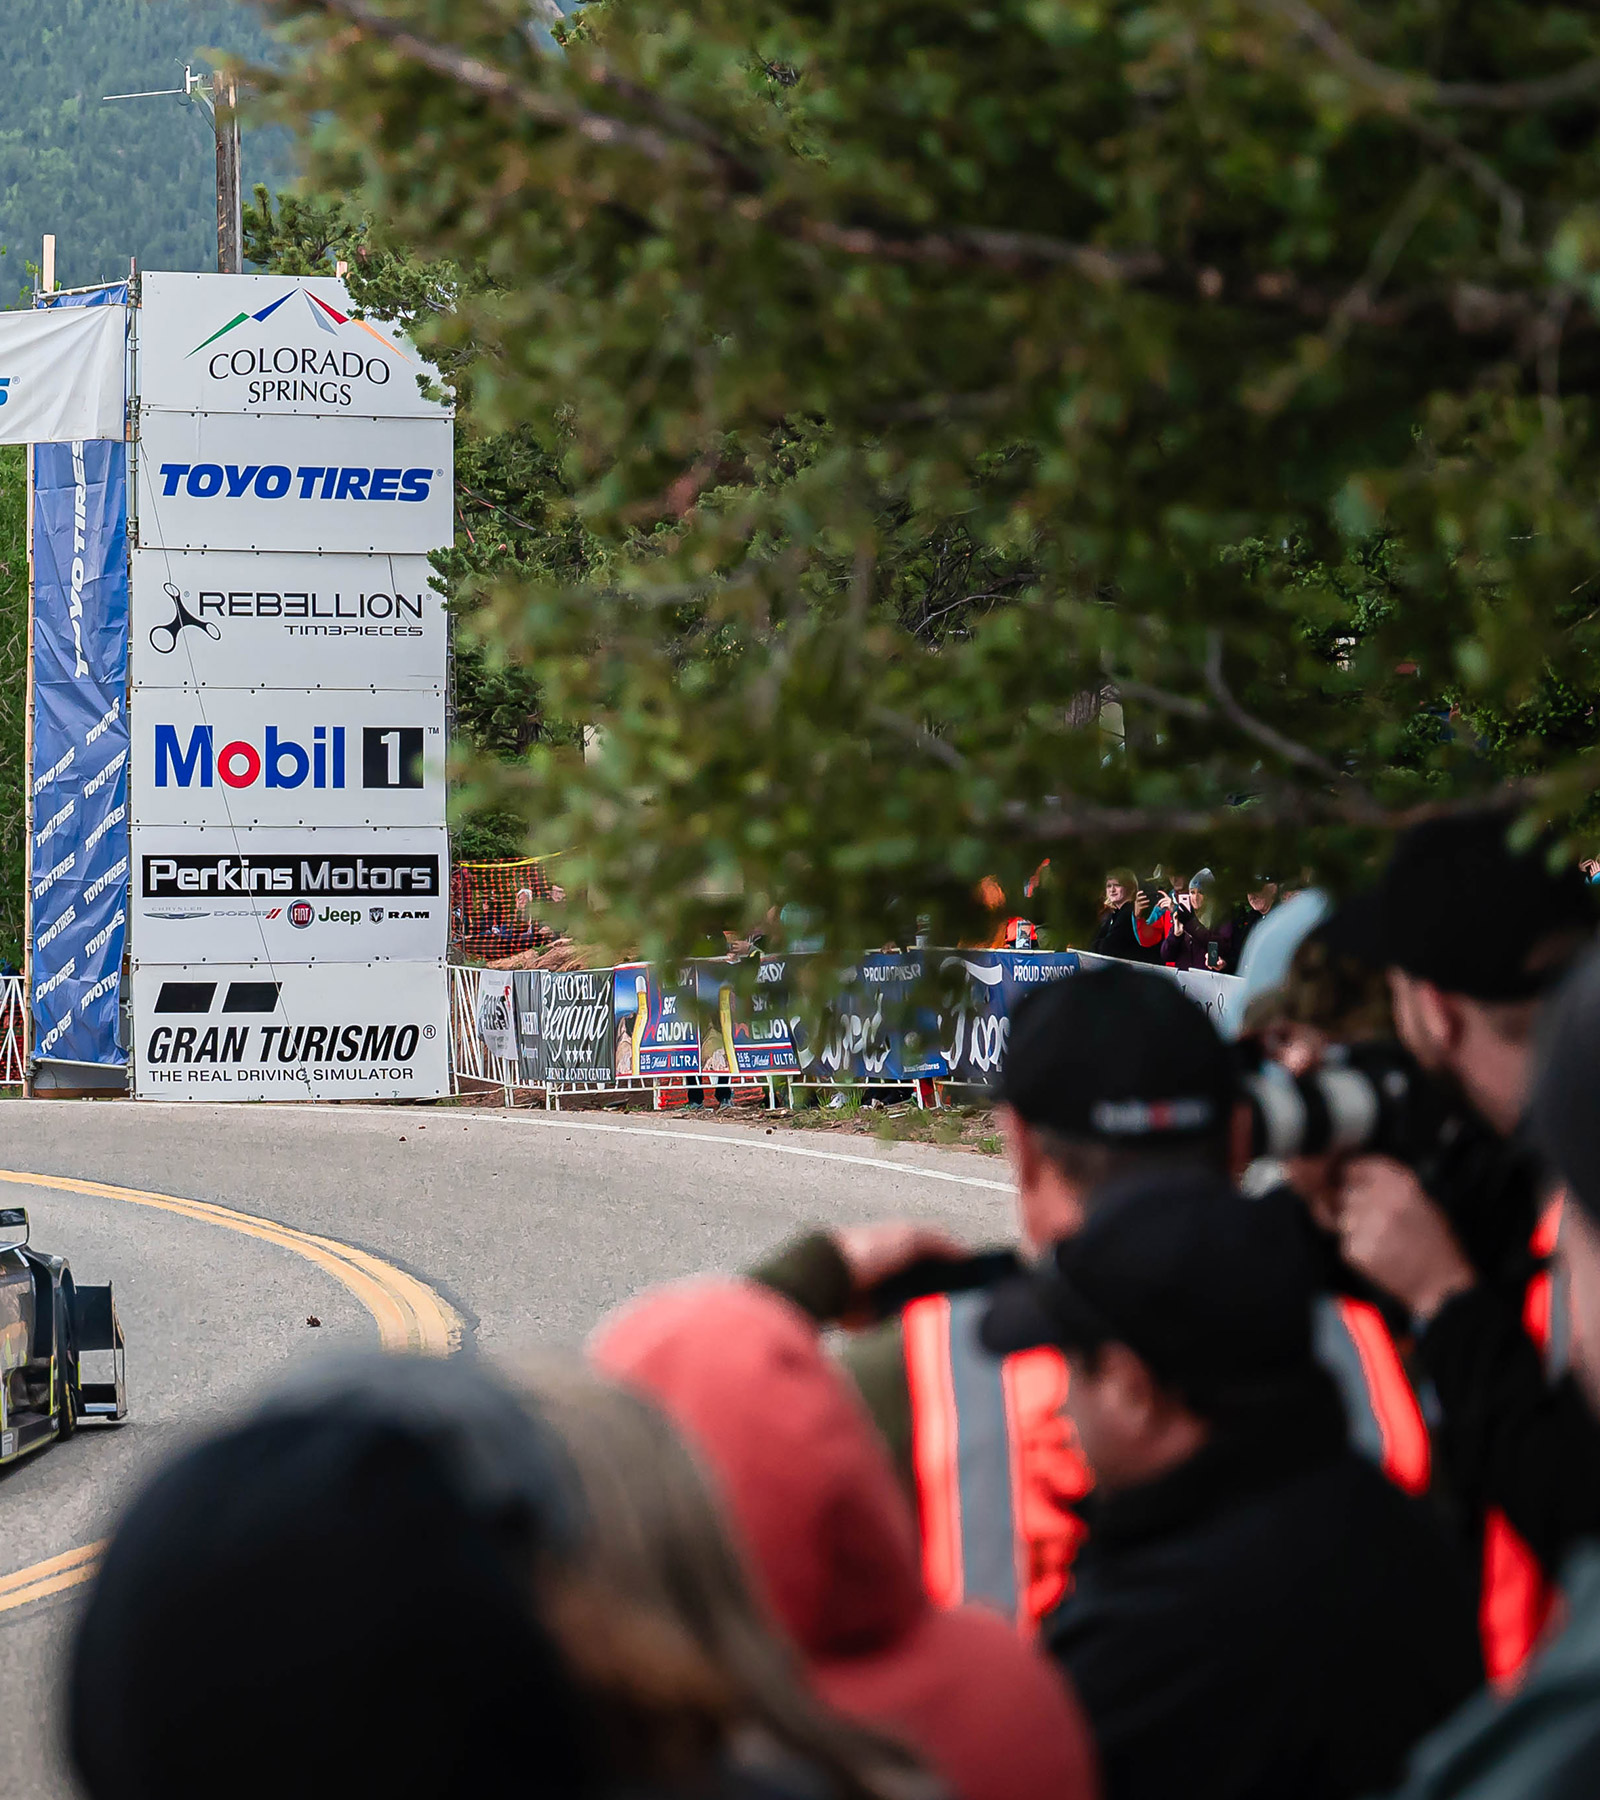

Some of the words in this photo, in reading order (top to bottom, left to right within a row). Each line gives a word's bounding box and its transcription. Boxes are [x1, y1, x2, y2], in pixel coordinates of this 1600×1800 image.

[208, 347, 391, 385] COLORADO
[247, 379, 352, 406] SPRINGS
[159, 463, 292, 499] TOYO
[295, 466, 433, 502] TIRES
[69, 557, 90, 679] TYO
[154, 724, 346, 789] Mobil
[149, 859, 293, 891] Perkins
[300, 858, 431, 891] Motors
[293, 908, 309, 922] FIAT
[317, 906, 362, 925] Jeep
[388, 911, 430, 919] RAM
[1013, 963, 1040, 983] PROUD
[557, 974, 597, 1001] HOTEL
[147, 1026, 249, 1064] GRAN
[259, 1024, 420, 1063] TURISMO
[149, 1070, 184, 1082] THE
[188, 1069, 232, 1082] REAL
[237, 1068, 307, 1082] DRIVING
[312, 1067, 414, 1081] SIMULATOR
[588, 1067, 611, 1080] CENTER
[670, 1055, 698, 1067] ULTRA
